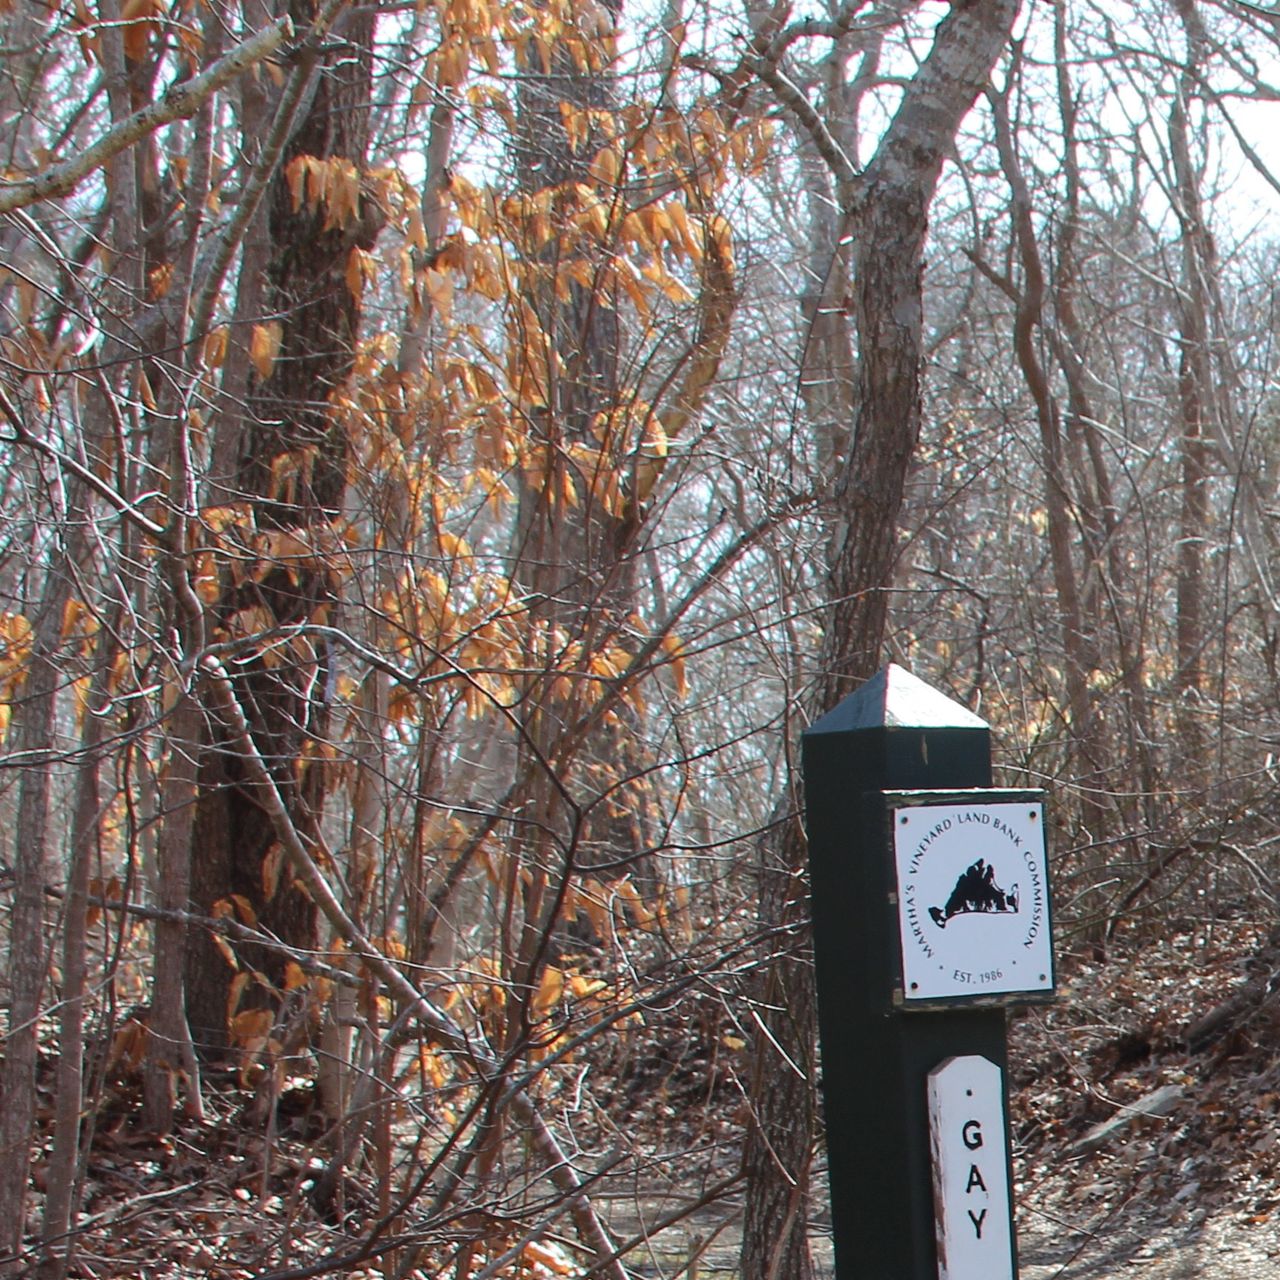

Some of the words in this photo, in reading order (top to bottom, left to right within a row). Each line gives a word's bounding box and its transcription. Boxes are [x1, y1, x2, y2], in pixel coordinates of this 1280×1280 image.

[909, 818, 952, 875] VINEYARD
[957, 812, 990, 824] LAND
[993, 818, 1023, 847] BANK
[905, 884, 935, 959] MARTHA'S
[1023, 851, 1043, 949] COMMISSION
[953, 969, 976, 984] EST.
[980, 968, 1003, 983] 1986
[962, 1119, 988, 1239] GAY
